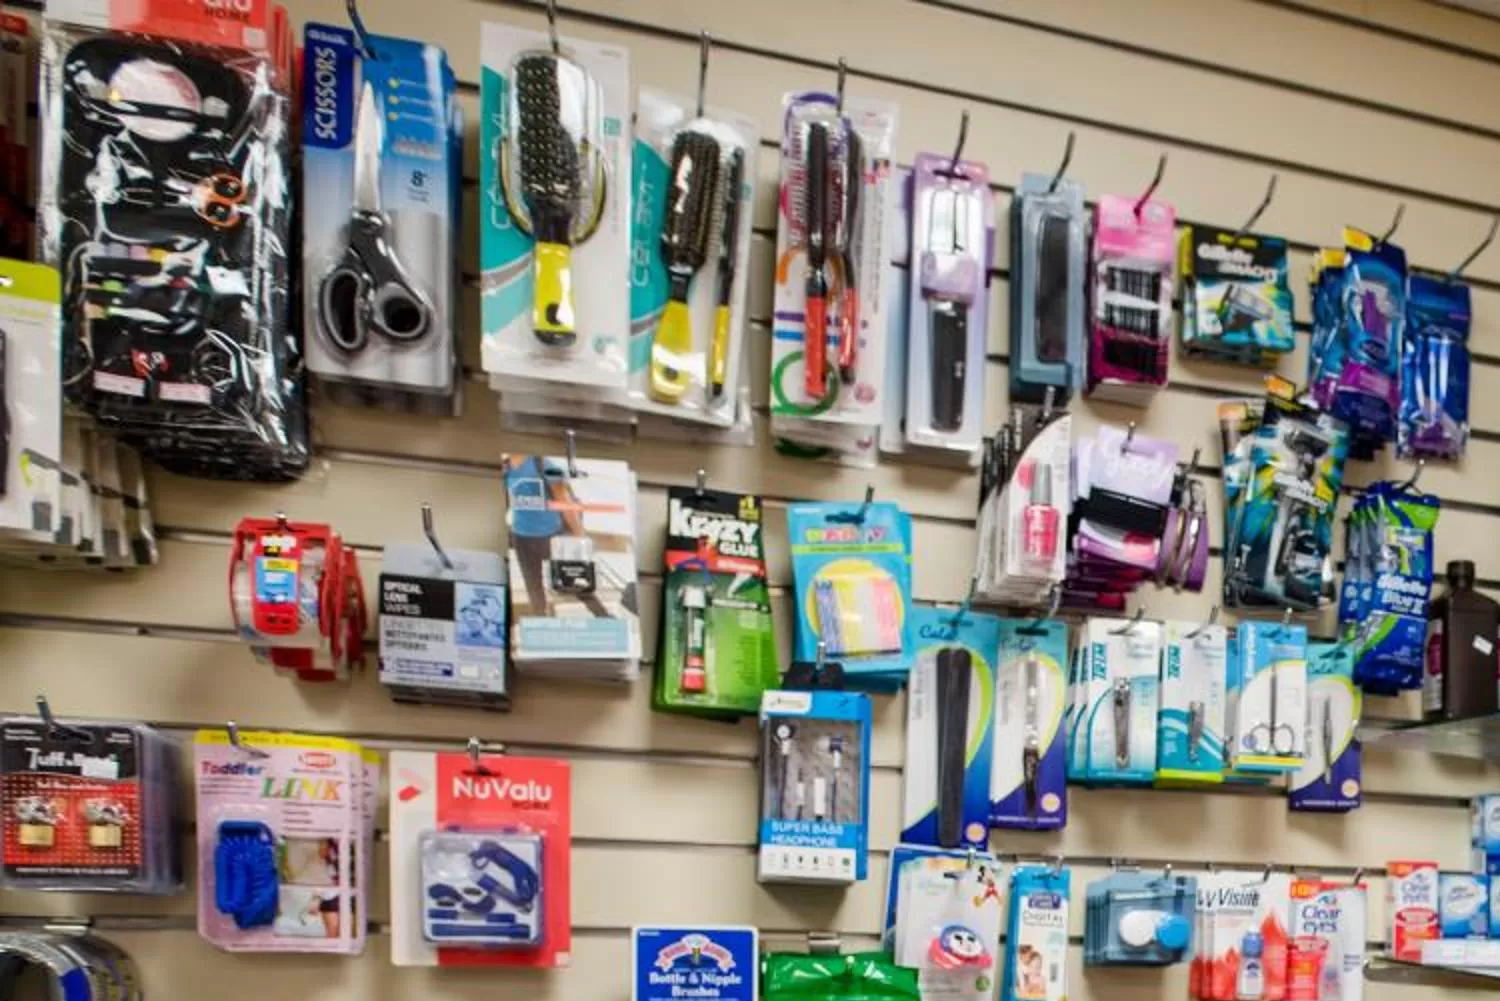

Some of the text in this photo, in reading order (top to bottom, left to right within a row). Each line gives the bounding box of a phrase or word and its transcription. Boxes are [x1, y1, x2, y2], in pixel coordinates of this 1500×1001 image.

[315, 47, 338, 141] SCISSORS
[383, 580, 422, 594] OPTICAL
[383, 603, 421, 616] WIPES
[201, 760, 263, 776] Toddler
[261, 776, 344, 801] LINK
[452, 776, 553, 802] NuValu
[1302, 904, 1342, 922] Clear
[648, 971, 685, 986] Bottle
[701, 972, 742, 987] Nipple
